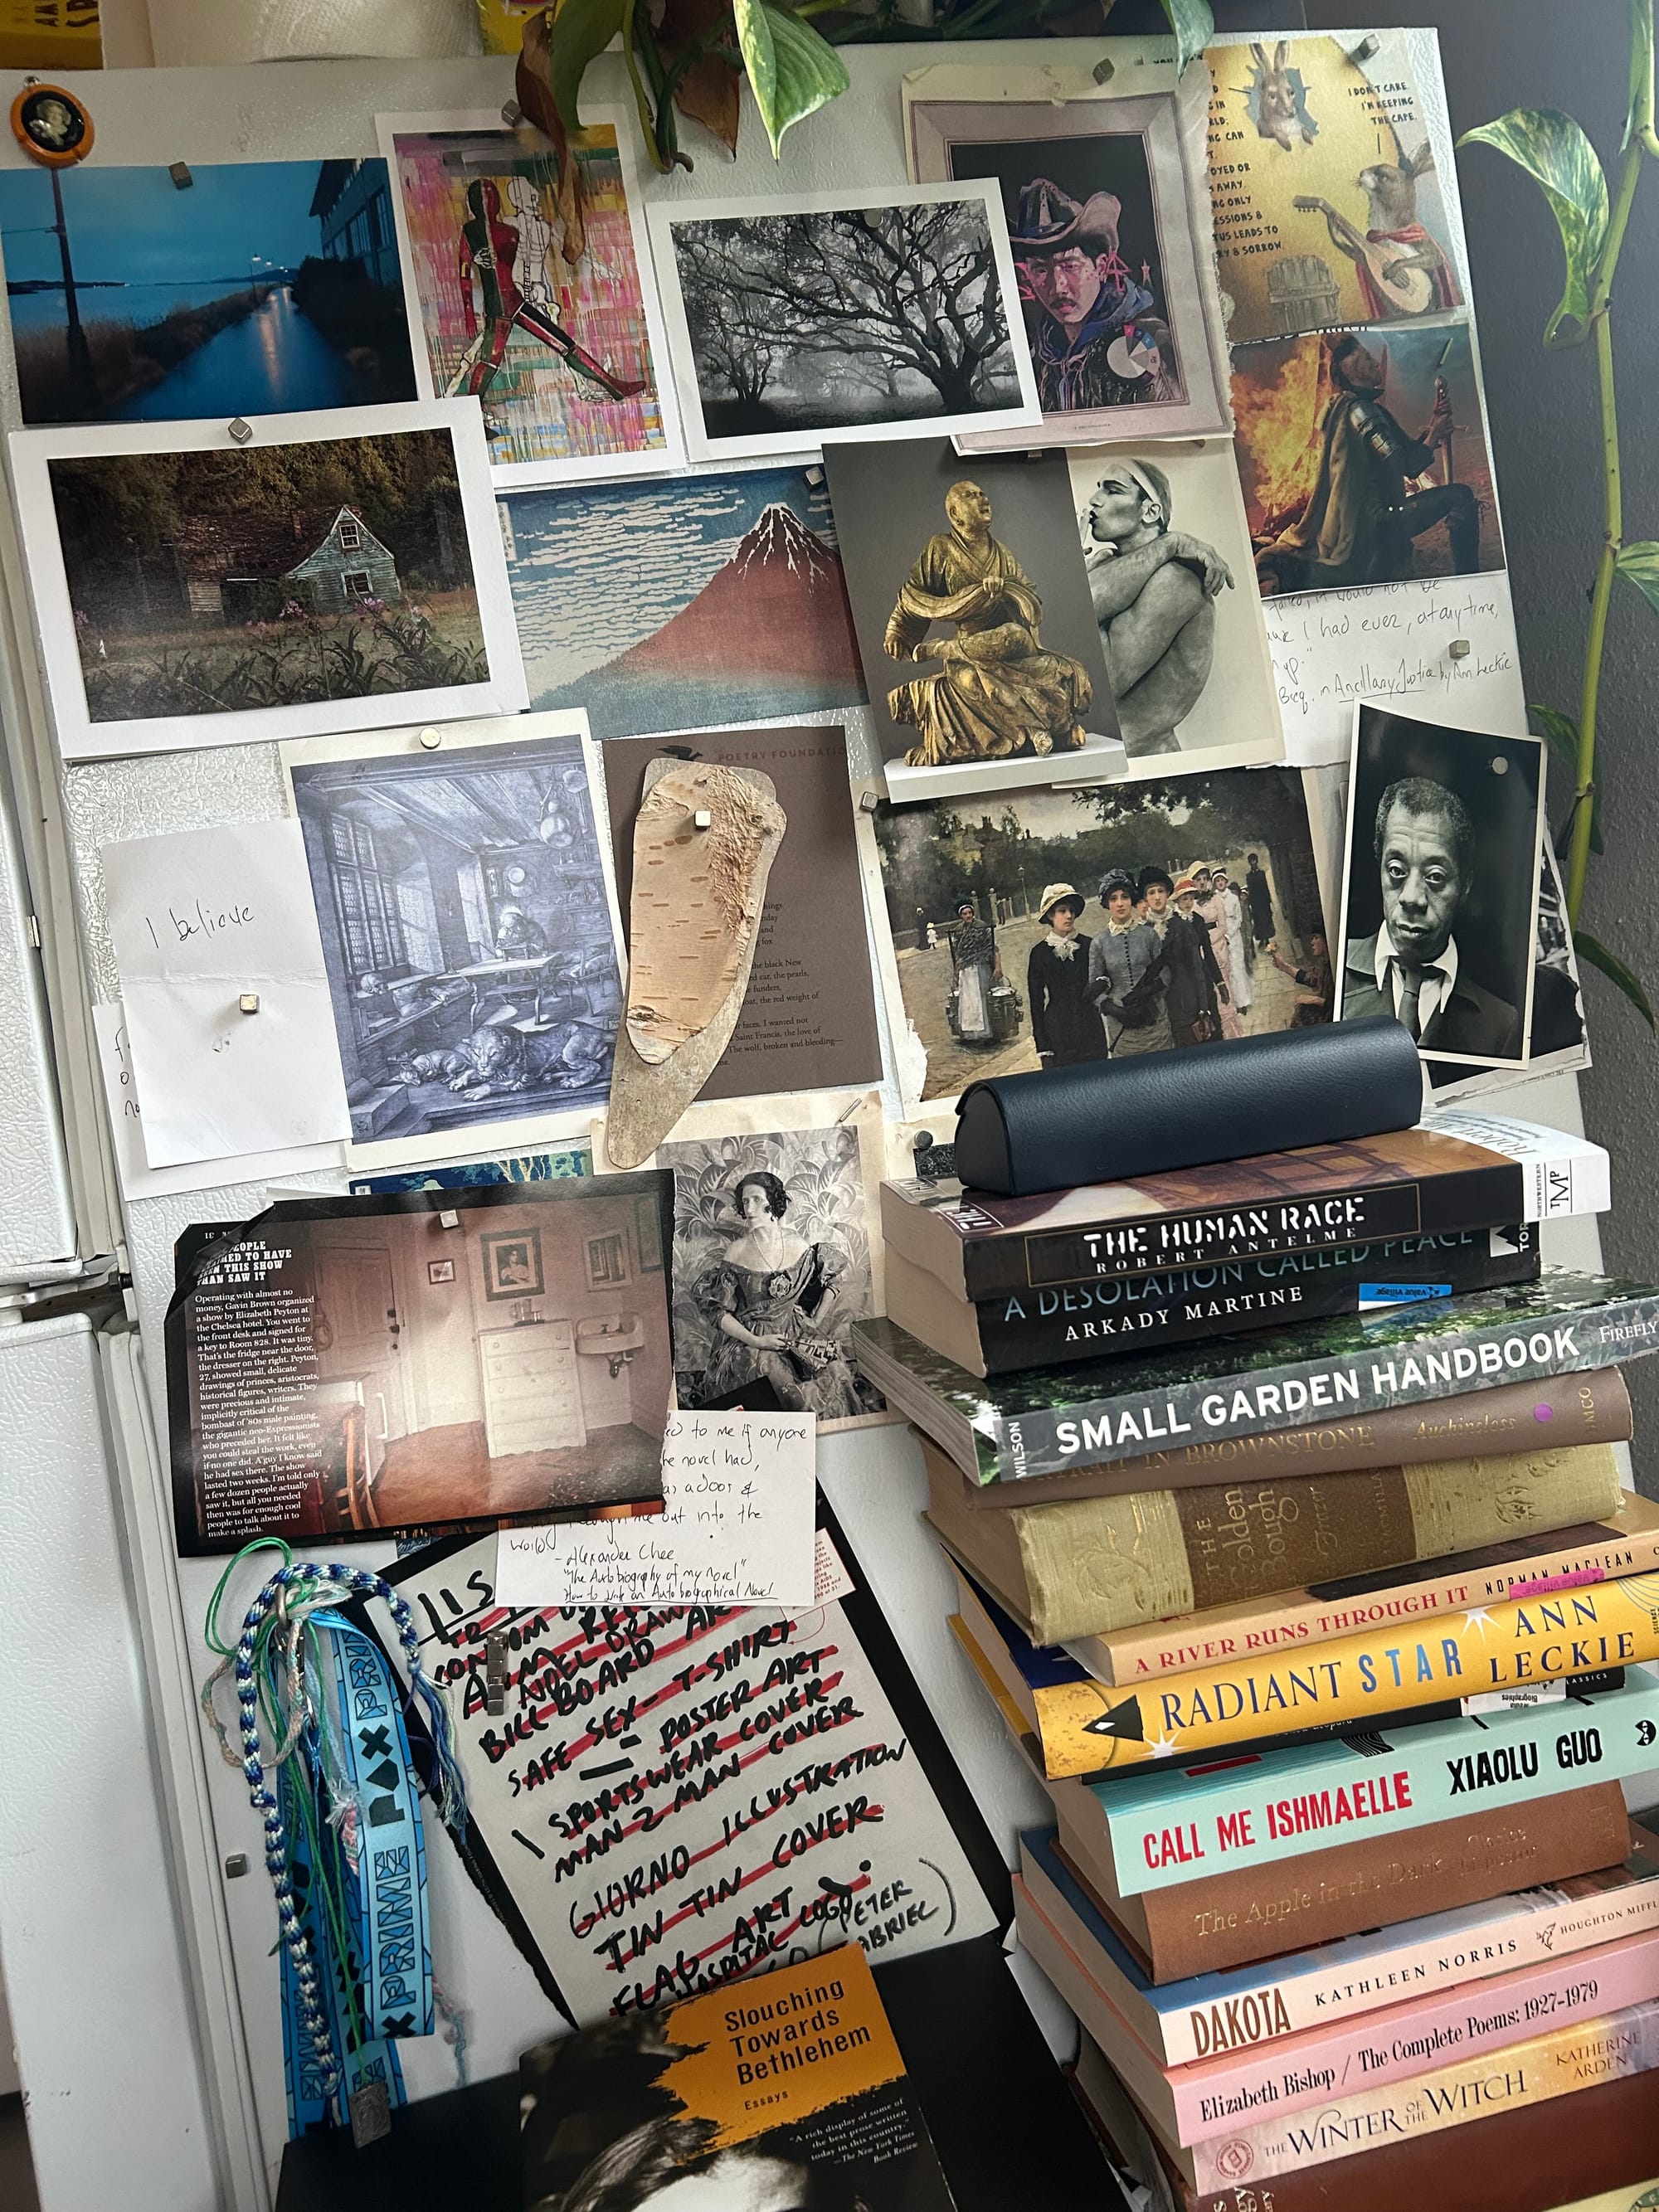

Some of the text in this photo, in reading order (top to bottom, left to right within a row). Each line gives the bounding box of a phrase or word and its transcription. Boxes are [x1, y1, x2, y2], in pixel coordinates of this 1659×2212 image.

[1353, 85, 1380, 96] DON'T
[1361, 97, 1413, 110] I'M KEEPING
[1226, 131, 1244, 140] CAN
[1372, 115, 1389, 125] THE
[1238, 163, 1251, 172] OR
[1228, 196, 1251, 207] ONLY
[1234, 227, 1262, 239] LEADS
[1264, 226, 1278, 235] TO
[1321, 617, 1350, 637] had
[718, 747, 846, 761] POETRY FOUNDATIO
[146, 899, 254, 948] I believe
[765, 960, 783, 968] black
[787, 970, 809, 980] pearls,
[744, 1043, 761, 1052] wolf,
[764, 1042, 788, 1050] broken
[790, 1039, 803, 1048] and
[755, 1031, 782, 1040] Francis,
[1083, 1196, 1365, 1258] THE HUMAN RACE
[224, 1260, 283, 1272] THIS SHOW
[246, 1249, 292, 1261] TO HAVE
[1096, 1227, 1358, 1274] ROBERT ANTELME
[195, 1292, 235, 1304] Operating
[236, 1291, 254, 1300] with
[255, 1290, 281, 1298] almost
[228, 1271, 265, 1283] SAW IT
[1004, 1296, 1027, 1321] A
[1257, 1244, 1370, 1279] CALLED
[1064, 1286, 1303, 1342] ARKADY MARTINE
[238, 1349, 260, 1359] fridge
[294, 1344, 314, 1353] door,
[1056, 1326, 1580, 1454] SMALL GARDEN HANDBOOK
[692, 1419, 707, 1439] to
[1185, 1426, 1375, 1465] BROWNSTONE
[1012, 1421, 1028, 1480] WILSON
[208, 1525, 264, 1538] make splash.
[738, 1502, 762, 1524] the
[1196, 1517, 1220, 1576] THE
[417, 1570, 495, 1645] LIS
[1515, 1595, 1598, 1638] ANN
[1135, 1585, 1469, 1675] A RIVER RUNS THROUGH IT
[660, 1649, 825, 1753] POSTER ART
[1160, 1631, 1635, 1732] RADIANT STAR LECKIE
[1501, 1694, 1538, 1702] Biographies
[508, 1620, 790, 1797] SAFE SEX T-SHIRT
[739, 1678, 830, 1741] COVER
[554, 1695, 864, 1883] MAN 2 MAN COVER
[1143, 1728, 1603, 1870] CALL ME ISHMAELLE XIAOLU GUO
[595, 1794, 882, 1973] TIN TIN COVER
[1195, 1854, 1443, 1937] The Apple in the Dark
[732, 1886, 793, 1953] ART
[1560, 1900, 1659, 1935] HOUGHTON MIFFL
[725, 1980, 844, 2032] Slouching
[1190, 1939, 1519, 2056] DAKOTA KATHLEEN NORRIS
[730, 2009, 839, 2057] Towards
[737, 2026, 871, 2085] Bethlehem
[1199, 2087, 1279, 2122] Elizabeth
[1283, 2064, 1335, 2098] Bishop
[1359, 2047, 1389, 2072] The
[1392, 2023, 1463, 2061] Complete
[1467, 2008, 1520, 2039] Poems:
[1555, 2031, 1642, 2080] KATHERINE ARDEN
[745, 2090, 788, 2110] Essays
[805, 2098, 903, 2139] rich display of some of
[1264, 2069, 1527, 2156] THE WINTER OF THE WITCH
[812, 2110, 907, 2149] the best prose written
